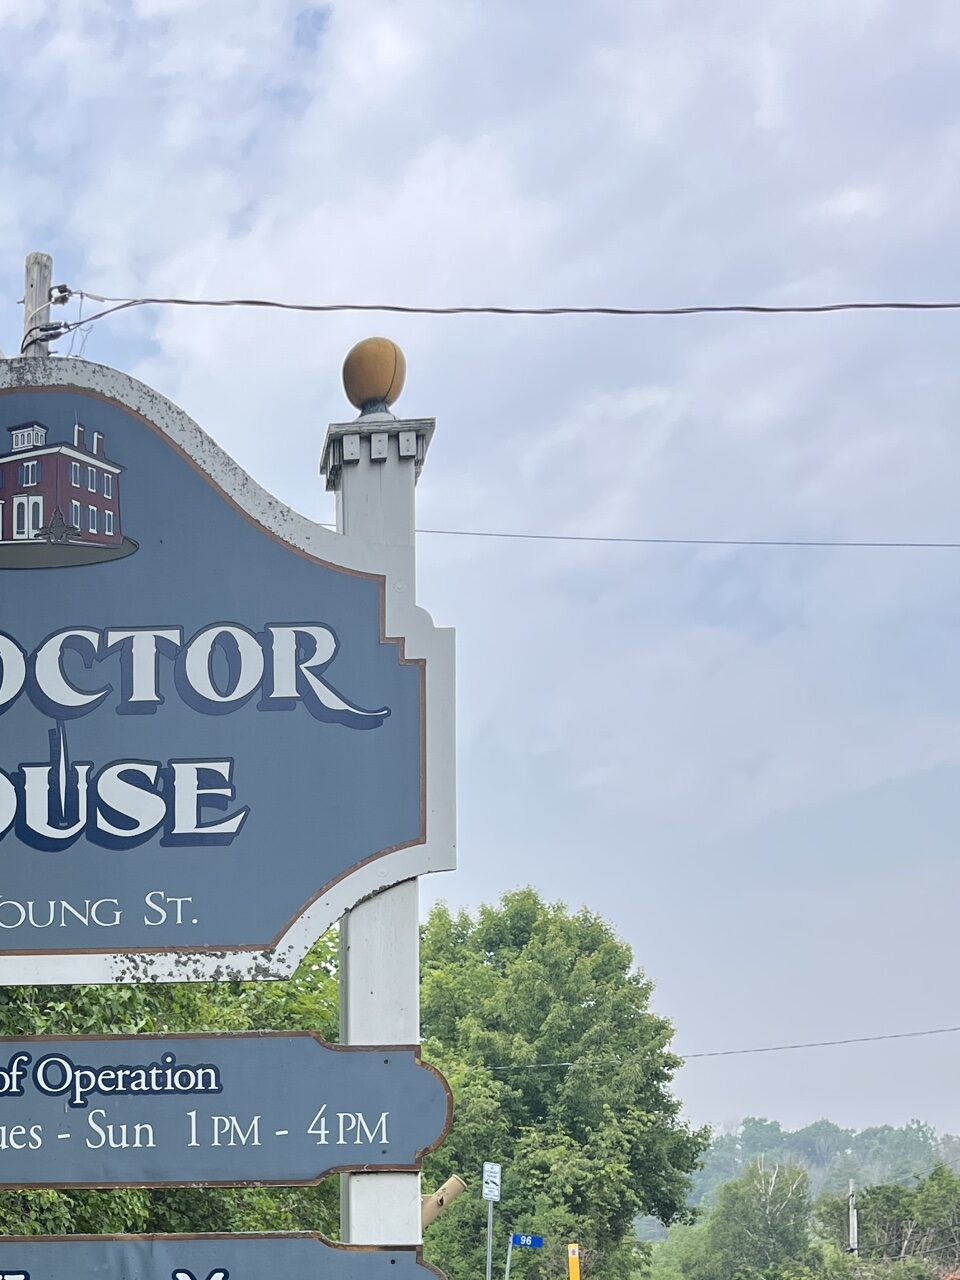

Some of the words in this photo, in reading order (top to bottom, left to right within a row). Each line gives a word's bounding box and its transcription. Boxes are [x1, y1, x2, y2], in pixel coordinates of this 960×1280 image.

[144, 891, 199, 927] ST.
[36, 1055, 220, 1104] Operation
[85, 1109, 157, 1149] Sun
[520, 1235, 532, 1245] 96
